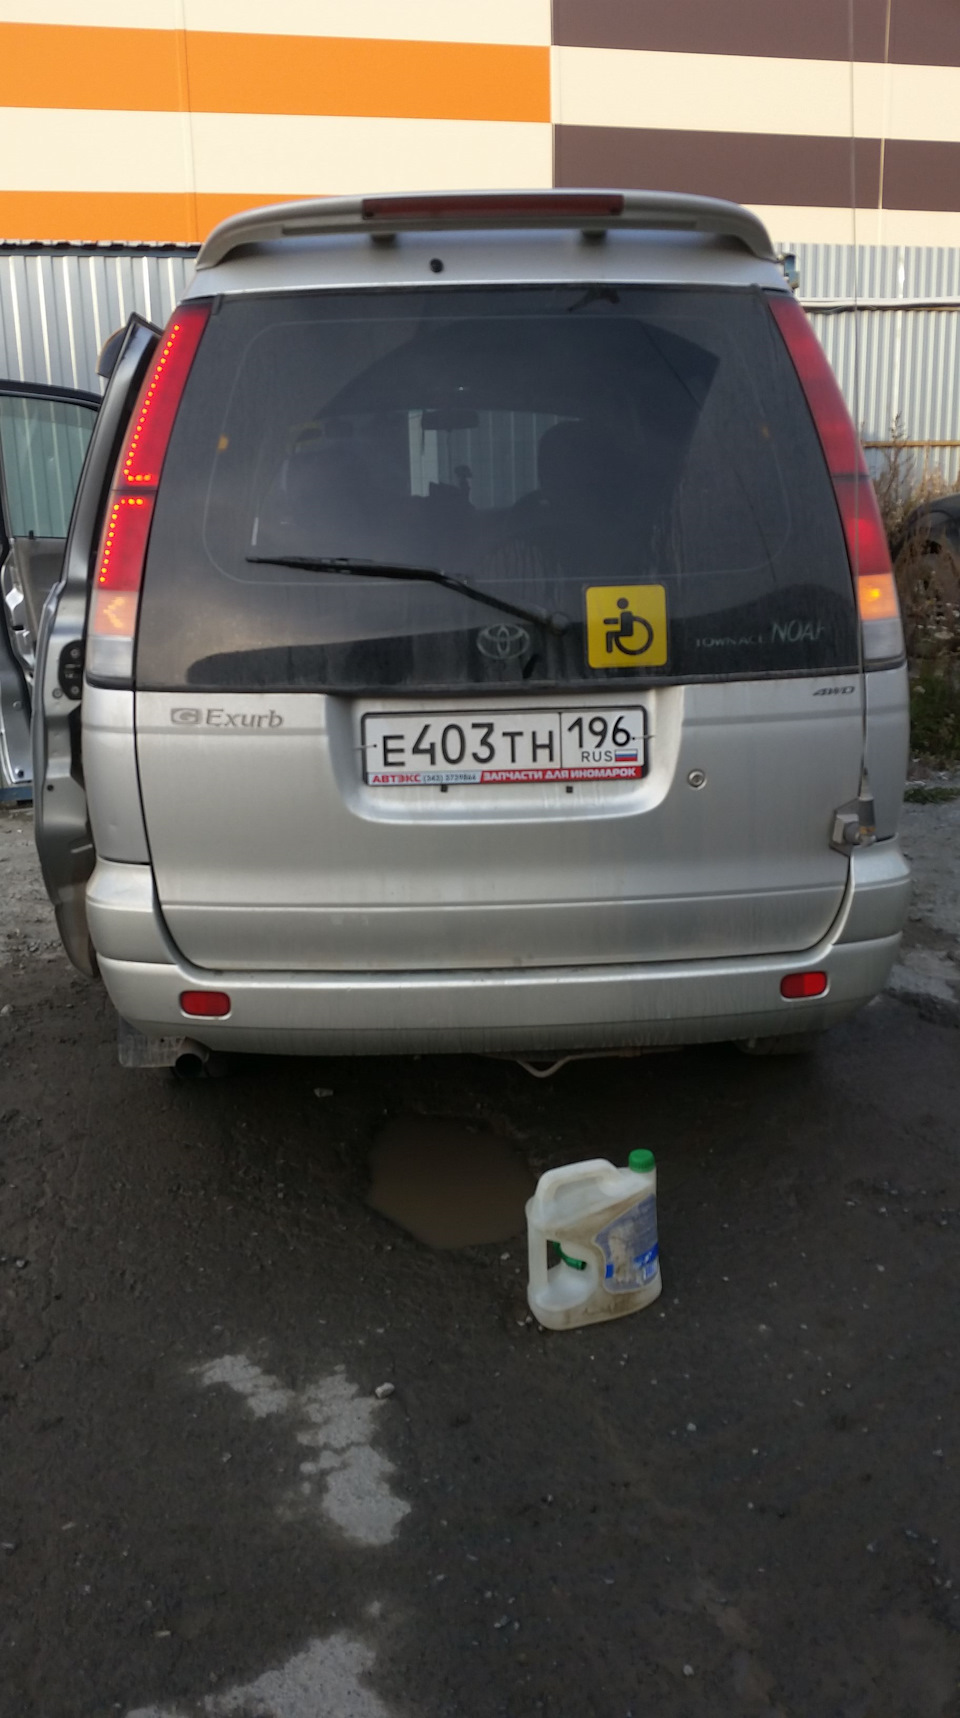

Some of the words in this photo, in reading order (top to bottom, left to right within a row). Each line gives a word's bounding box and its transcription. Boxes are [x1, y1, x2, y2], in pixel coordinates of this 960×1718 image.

[812, 686, 855, 696] 4WD
[206, 708, 284, 728] Exurb
[567, 716, 632, 749] 196
[581, 750, 613, 763] RUS
[372, 773, 422, 784] АВТЭКС
[483, 770, 543, 782] ЗАПЧАСТИ
[545, 769, 569, 780] ДЛЯ
[571, 767, 637, 779] ИНОМАРОК
